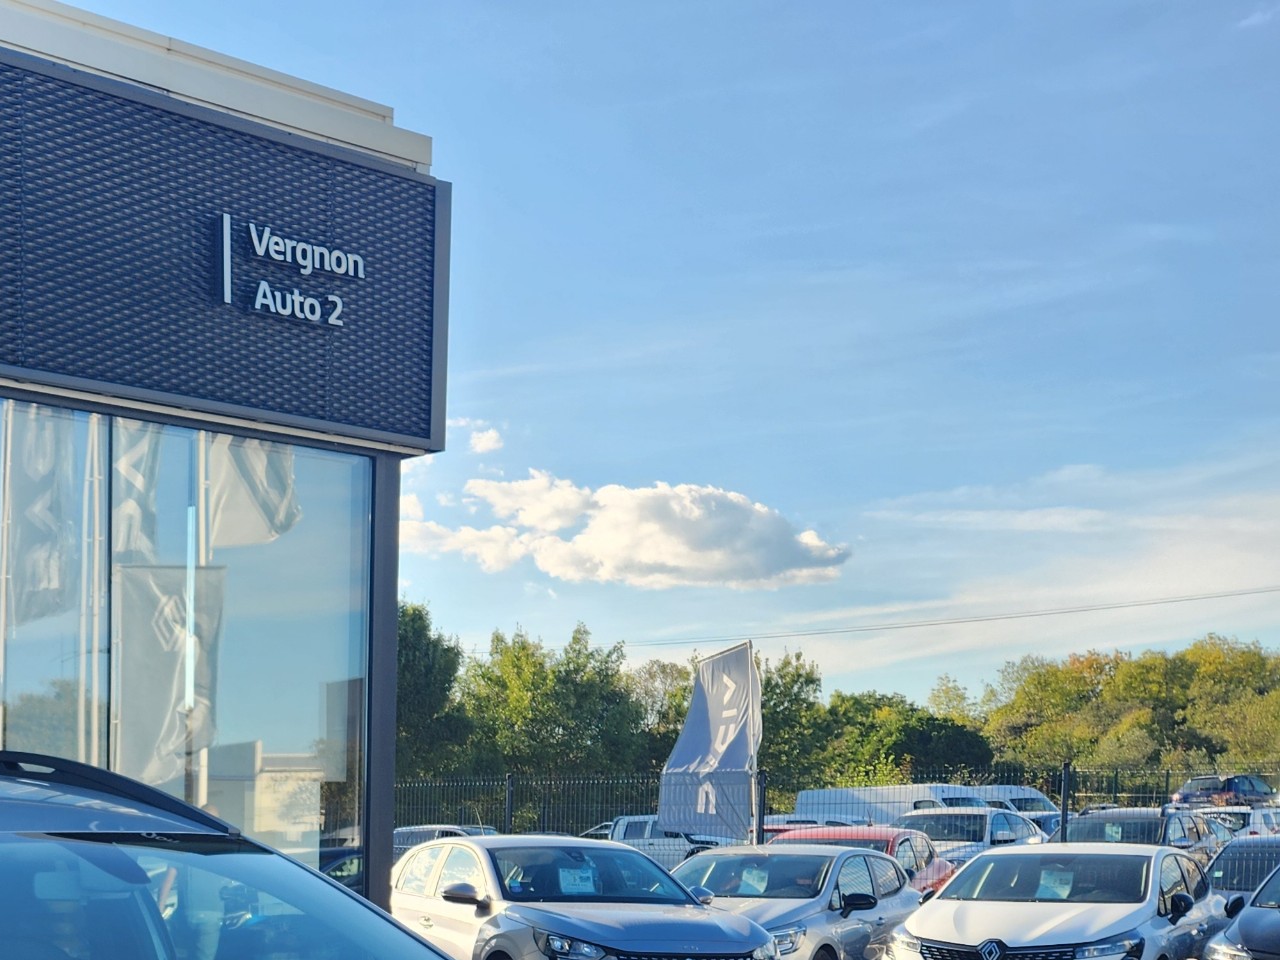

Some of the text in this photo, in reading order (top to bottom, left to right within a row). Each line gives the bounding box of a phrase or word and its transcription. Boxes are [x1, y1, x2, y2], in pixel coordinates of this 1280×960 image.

[248, 223, 365, 279] Vergnon
[254, 280, 344, 327] Auto 2
